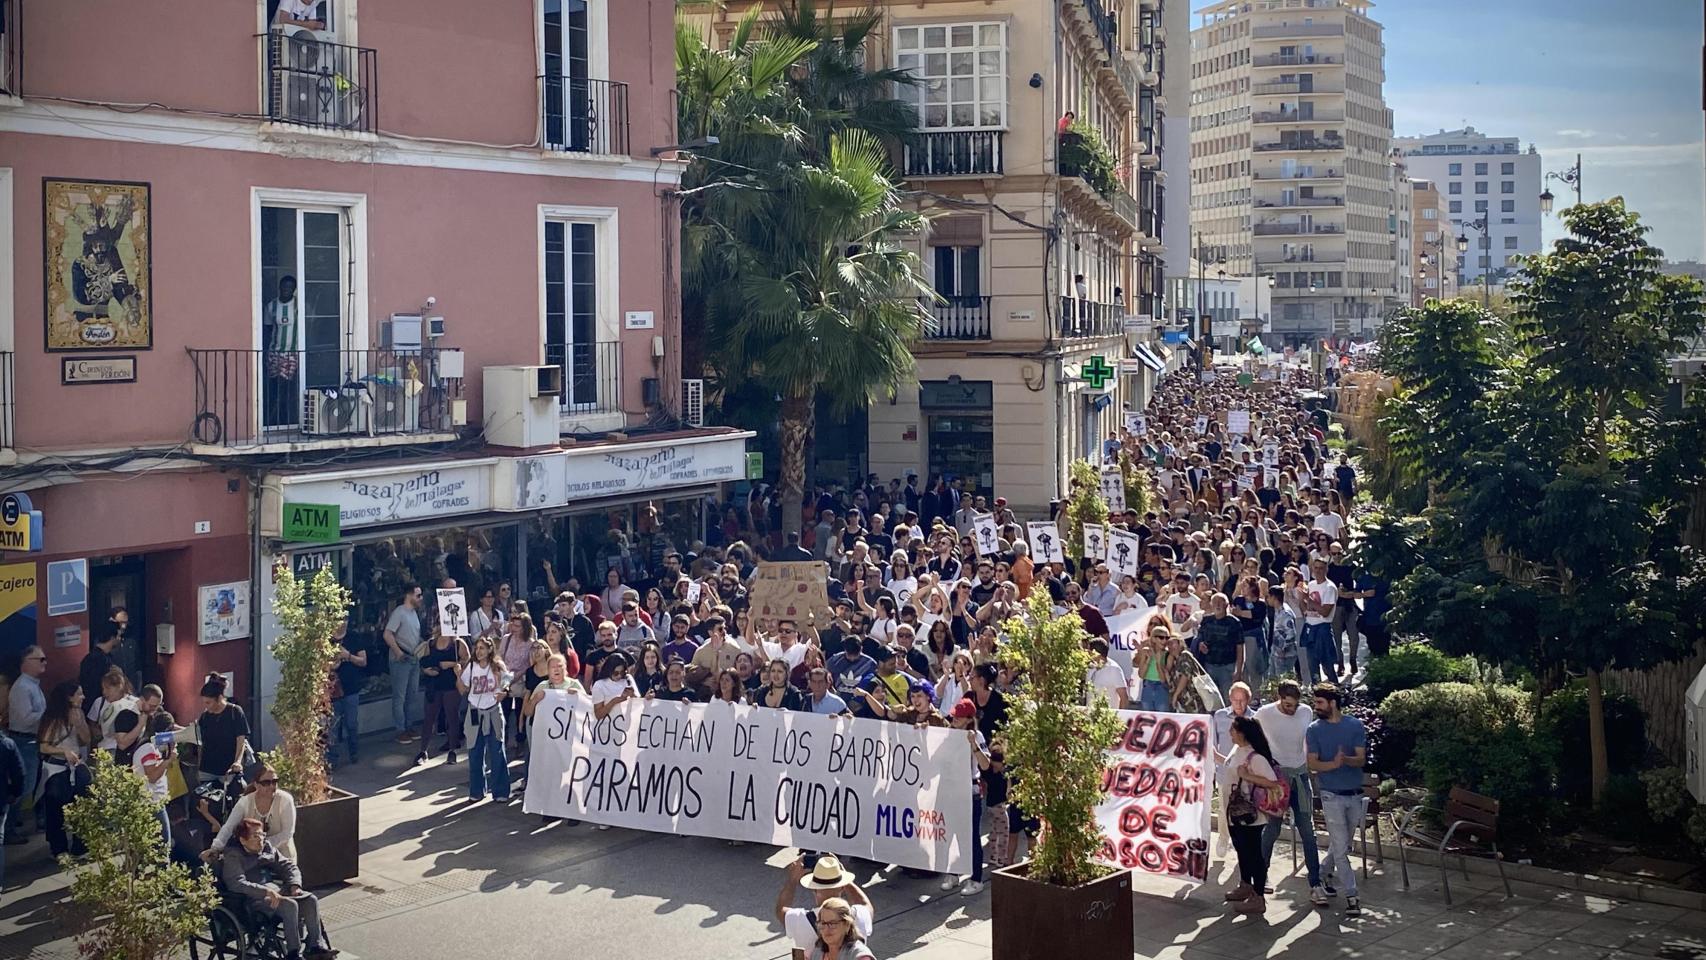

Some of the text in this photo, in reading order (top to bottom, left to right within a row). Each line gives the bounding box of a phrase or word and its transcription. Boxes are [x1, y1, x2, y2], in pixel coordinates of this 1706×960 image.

[292, 508, 329, 528] ATM
[340, 496, 469, 520] ELIGIOSOS COFRADES
[298, 552, 331, 571] ATM
[61, 571, 74, 596] P
[580, 712, 628, 747] NOS
[637, 714, 716, 753] ECHAN
[733, 722, 760, 760] DE
[772, 727, 812, 767] LOS
[566, 756, 861, 840] PARAMOS LA CIUDAD
[876, 803, 915, 839] MLG
[917, 810, 946, 825] PARA
[1118, 804, 1181, 843] DE
[913, 827, 948, 843] VIVIR
